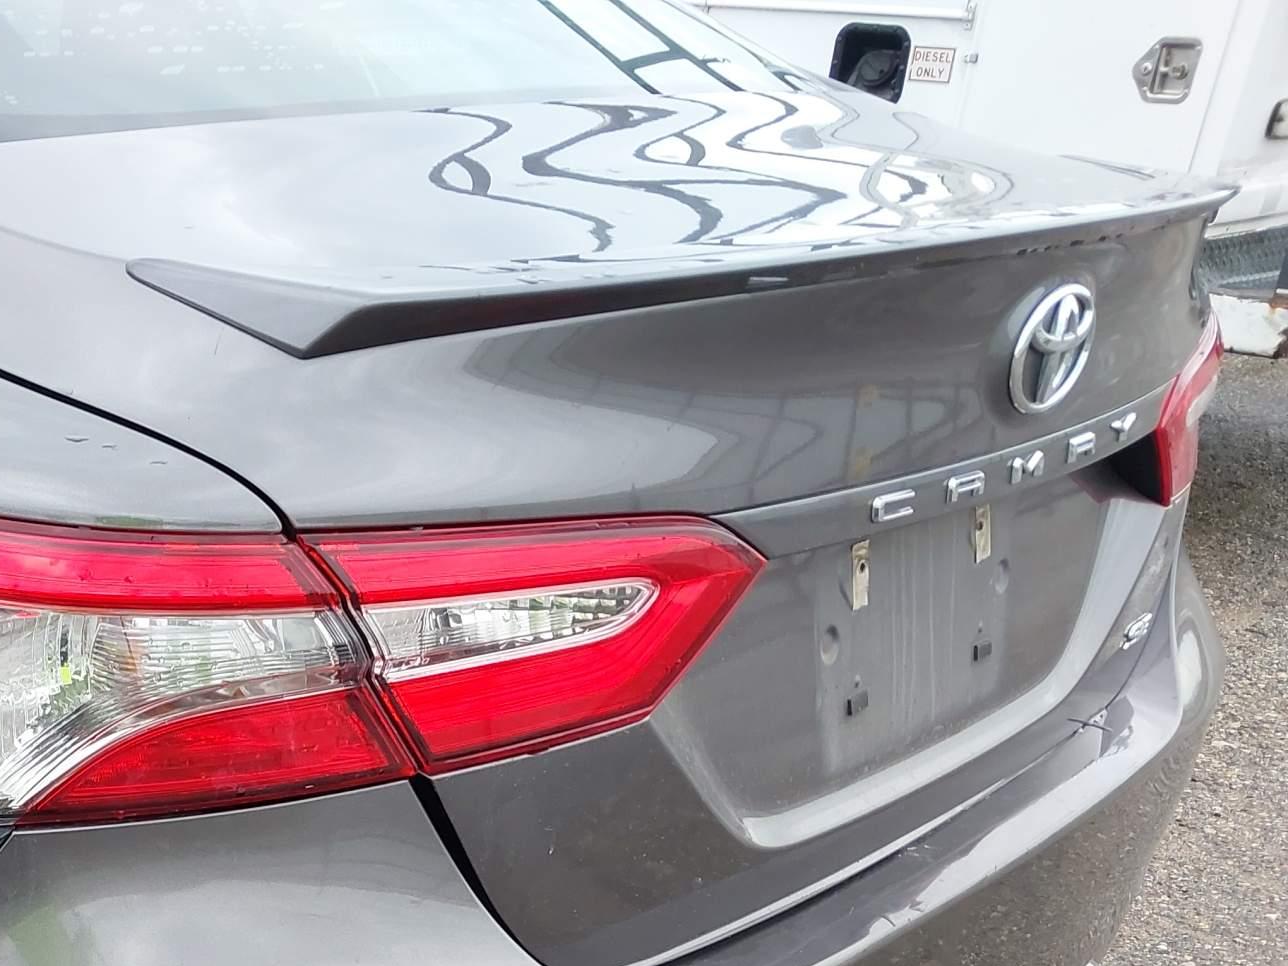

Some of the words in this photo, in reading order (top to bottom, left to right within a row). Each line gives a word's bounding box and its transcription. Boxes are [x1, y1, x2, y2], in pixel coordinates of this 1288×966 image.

[914, 50, 951, 63] DIESEL
[916, 66, 945, 78] ONLY
[870, 411, 1137, 522] CAMRY
